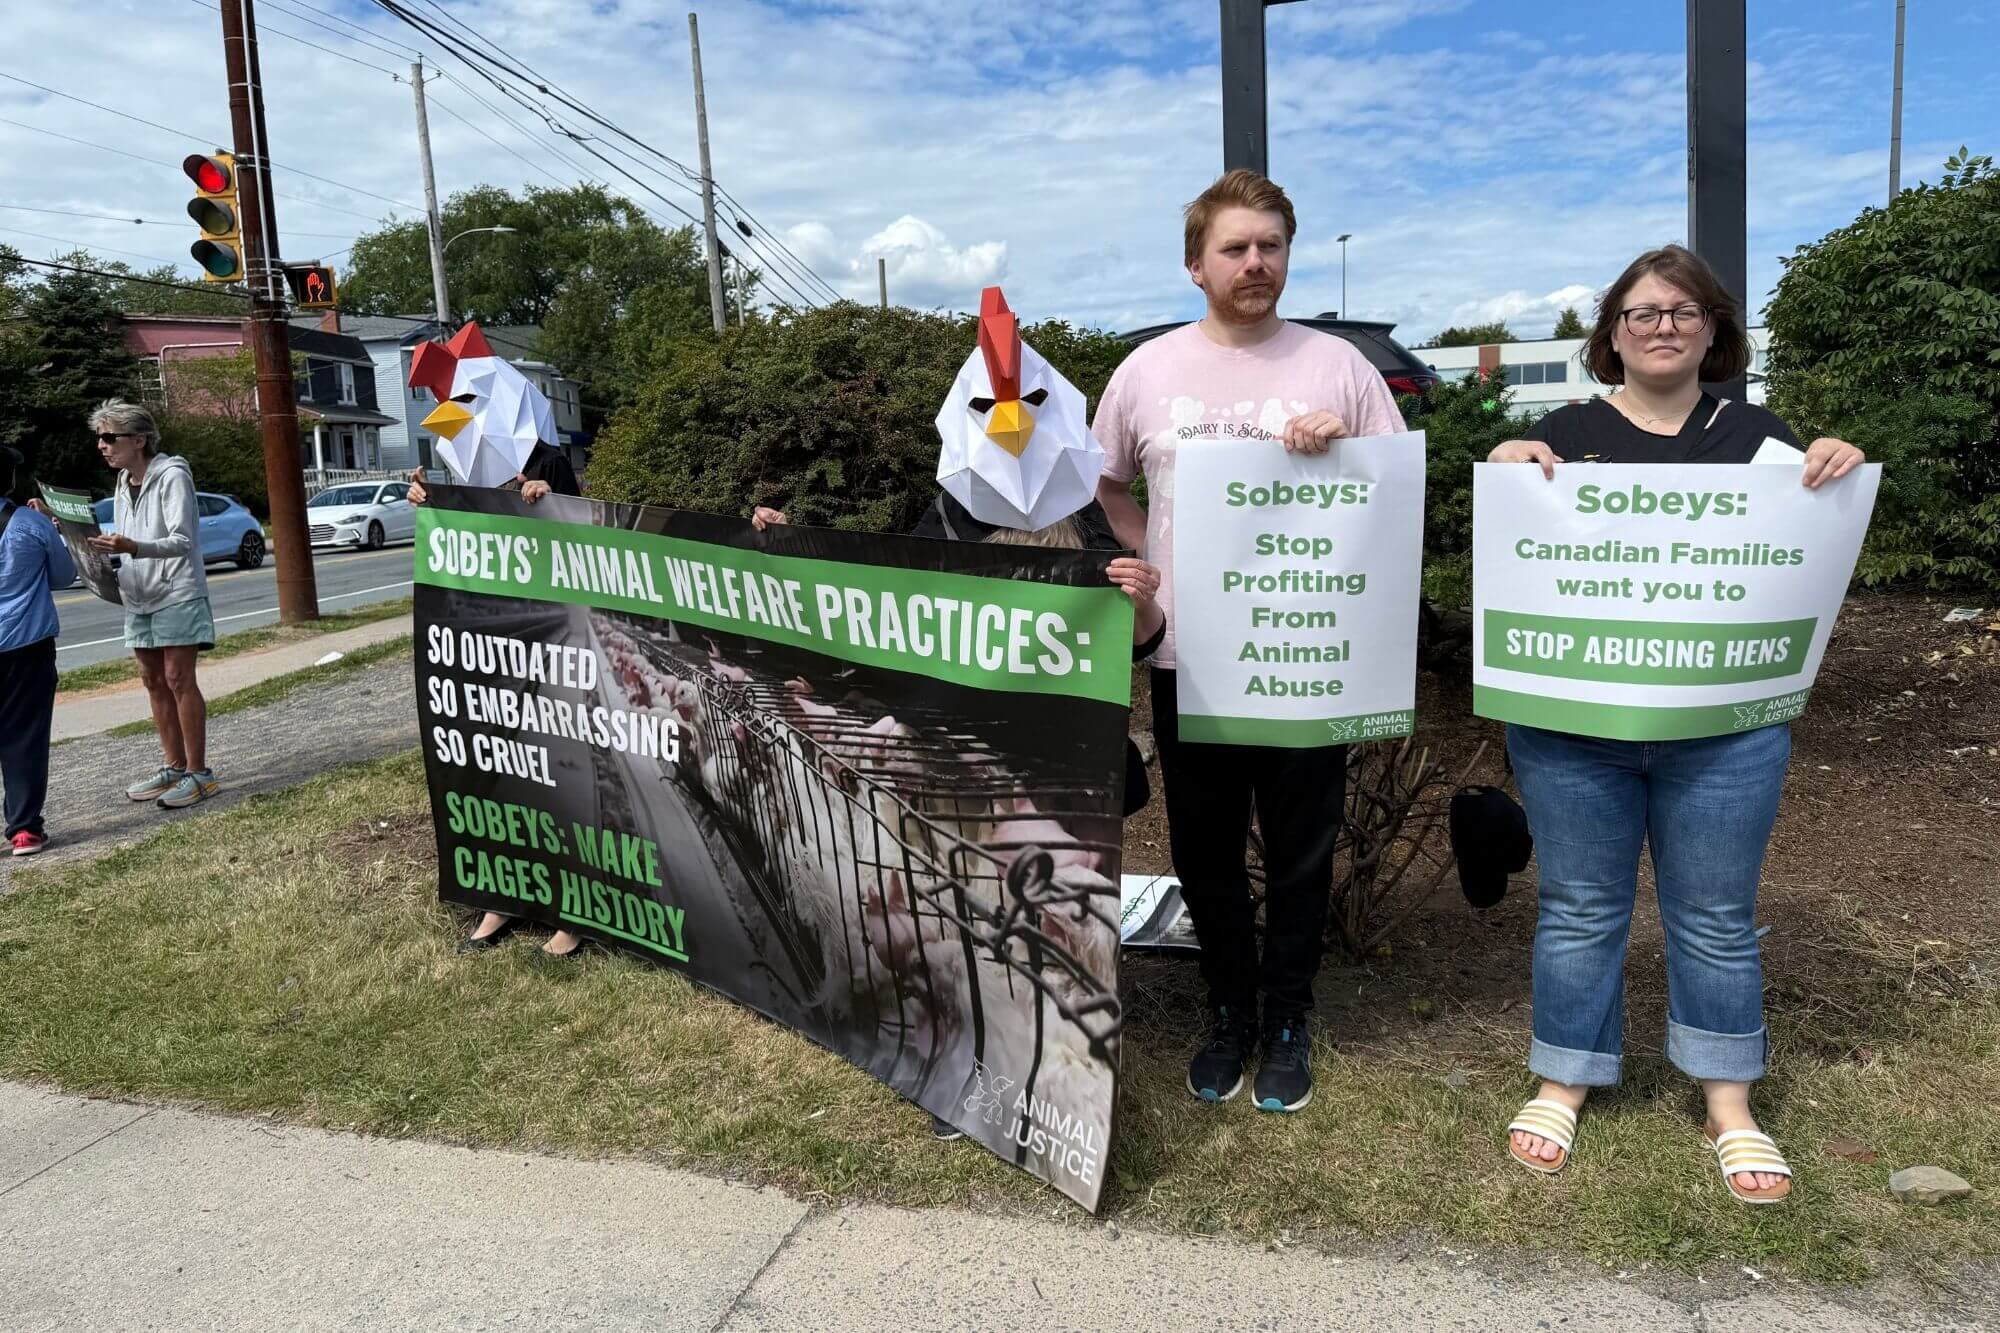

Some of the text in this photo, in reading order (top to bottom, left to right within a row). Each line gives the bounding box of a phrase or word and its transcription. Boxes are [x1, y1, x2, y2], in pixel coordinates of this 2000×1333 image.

[1225, 480, 1368, 509] Sobeys:
[1575, 484, 1749, 521] Sobeys:
[1255, 533, 1333, 560] Stop
[1514, 538, 1805, 566] Canadian Families
[1223, 569, 1366, 595] Profiting
[1556, 576, 1746, 603] want you to
[551, 540, 663, 604] ANIMAL
[664, 555, 812, 636] WELFARE
[815, 583, 1092, 676] PRACTICES:
[1251, 607, 1337, 628] From
[428, 624, 597, 691] SO OUTDATED
[1238, 639, 1350, 663] Animal
[1505, 627, 1792, 669] STOP ABUSING HENS
[1244, 675, 1344, 698] Abuse
[1761, 702, 1805, 724] JUSTICE
[1766, 692, 1807, 712] ANIMAL
[428, 675, 681, 763] SO EMBARRASSING
[1360, 723, 1411, 738] JUSTICE
[1362, 712, 1411, 726] ANIMAL
[434, 725, 557, 788] SO CRUEL
[446, 791, 663, 888] SOBEYS: MAKE
[454, 846, 689, 954] CAGES HISTORY
[1013, 1089, 1097, 1154] ANIMAL
[1004, 1117, 1094, 1185] JUSTICE
